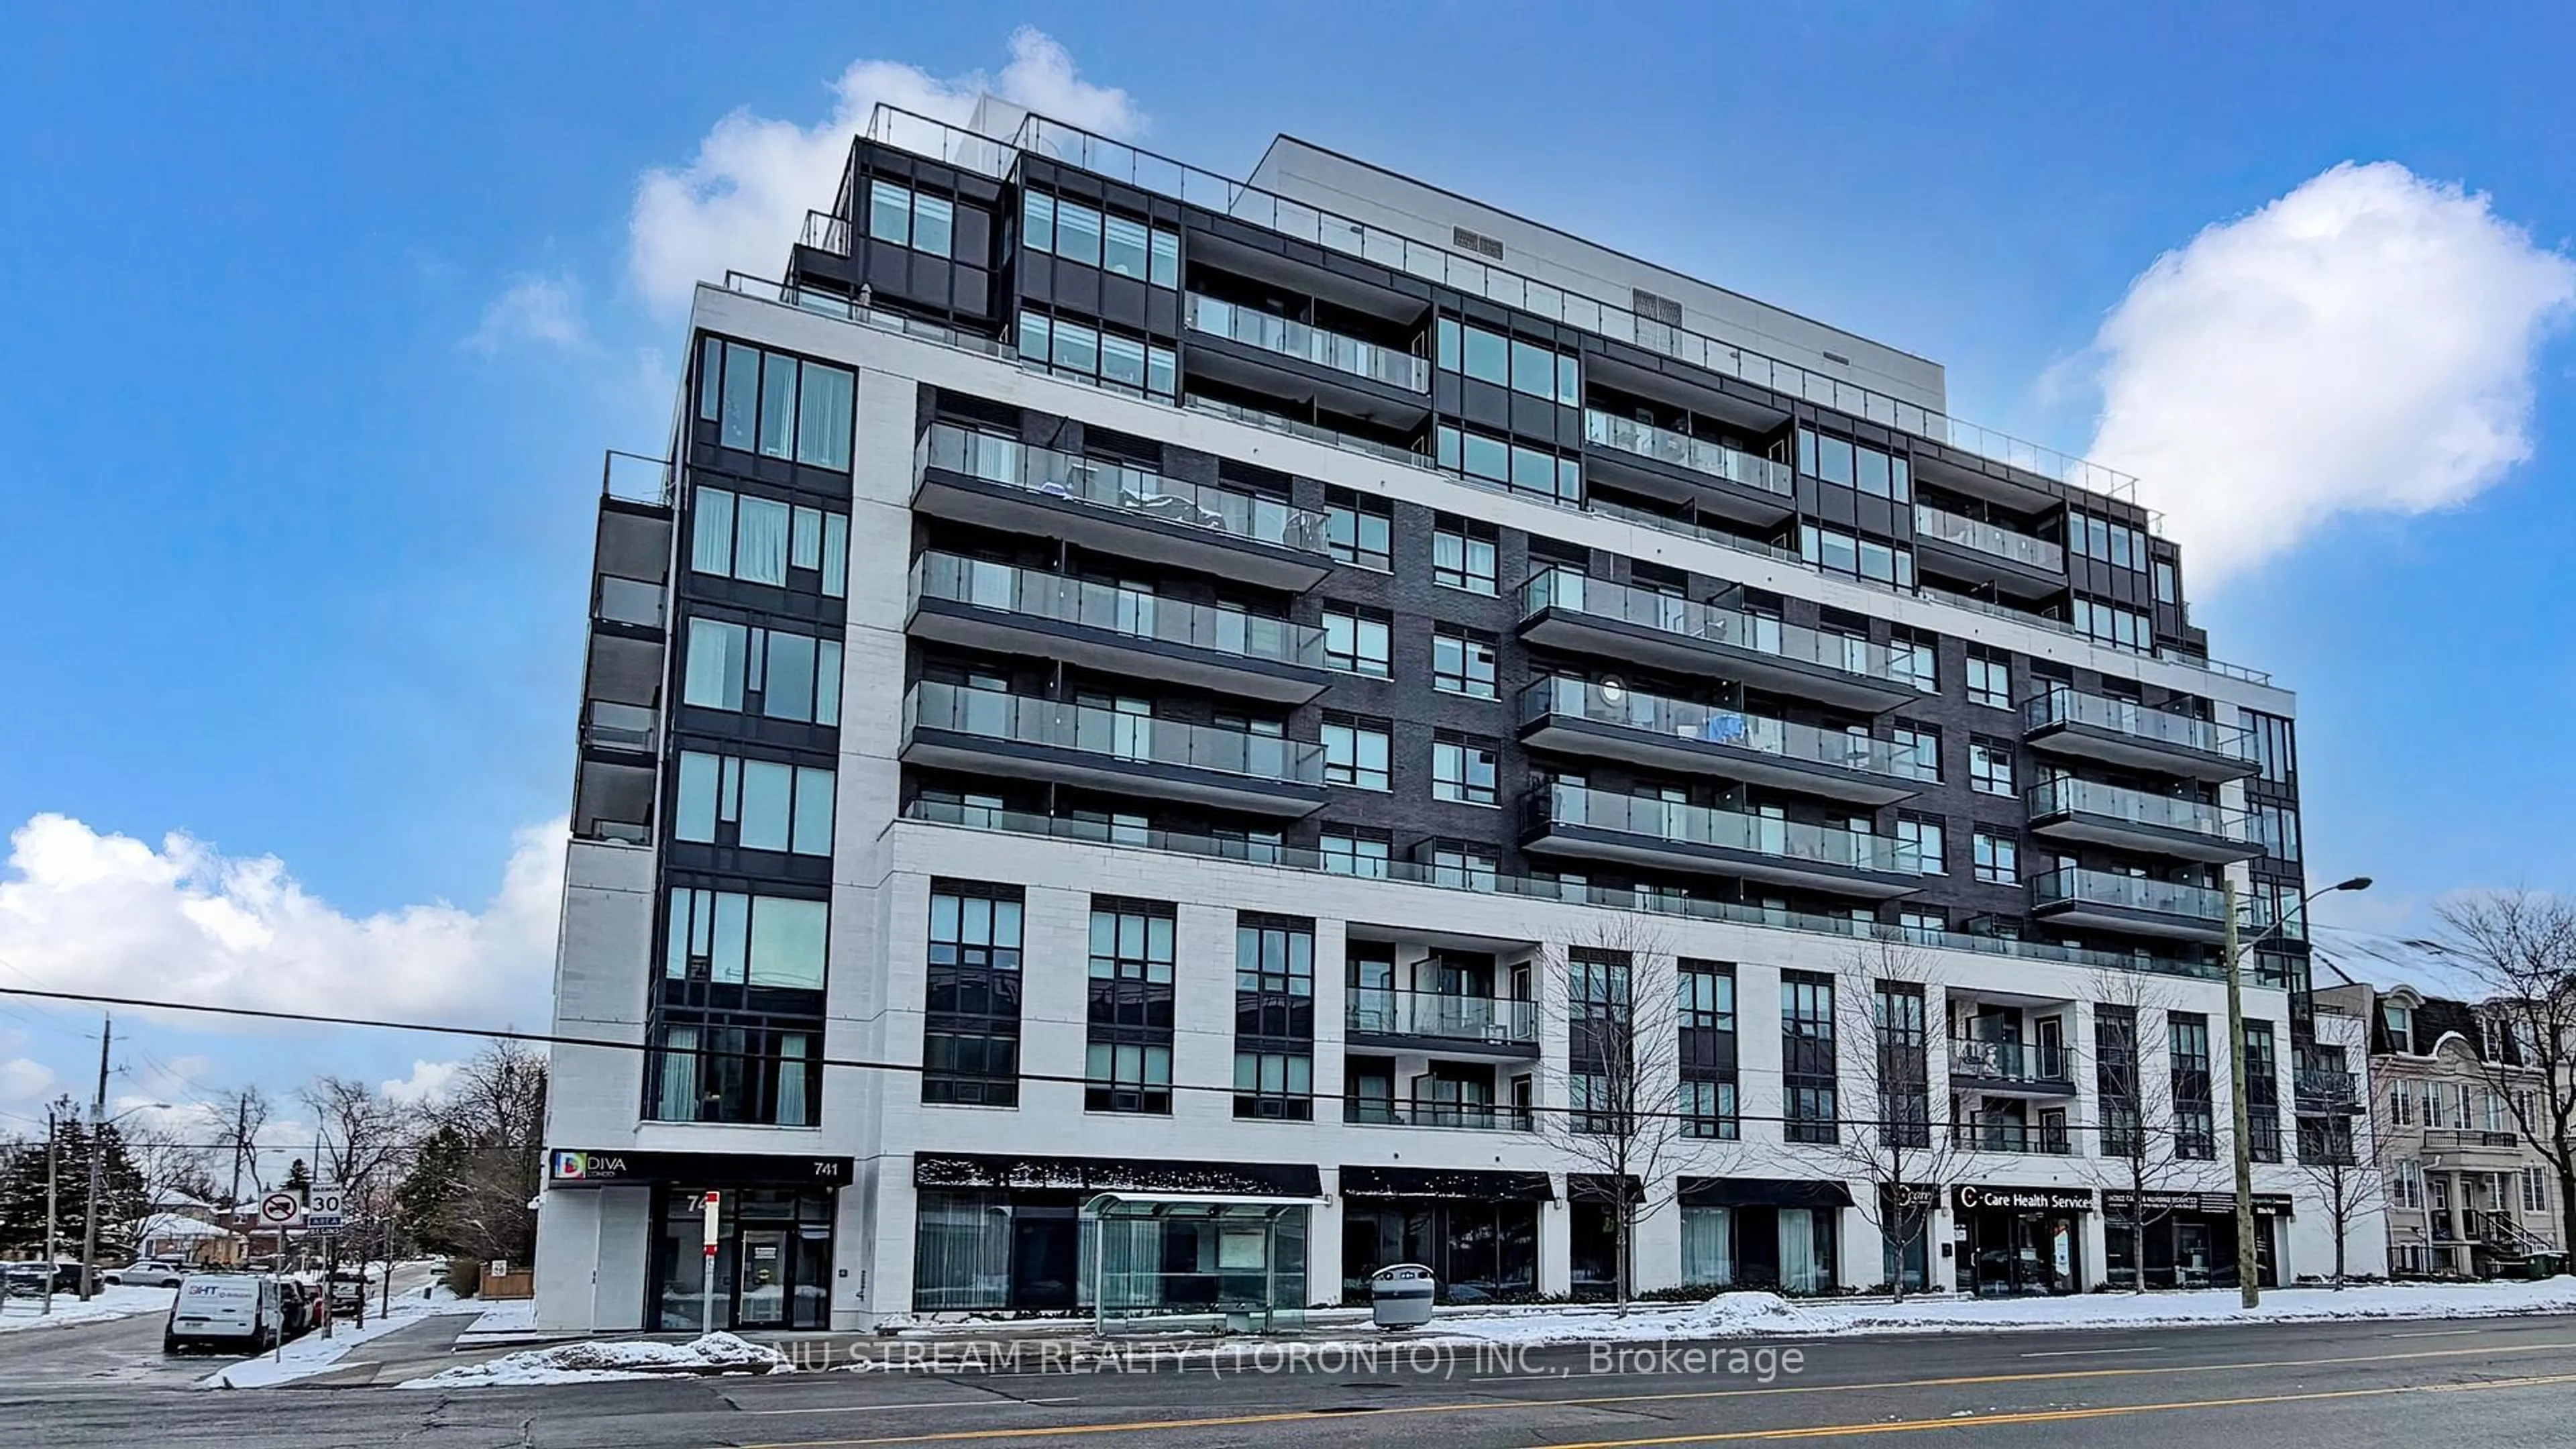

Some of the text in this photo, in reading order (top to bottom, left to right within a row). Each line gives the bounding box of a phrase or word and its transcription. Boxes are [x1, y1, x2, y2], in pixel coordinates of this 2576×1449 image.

[587, 1157, 627, 1171] DIVA
[814, 1162, 838, 1175] 741
[313, 1196, 339, 1212] 30
[2013, 1193, 2048, 1208] Health
[2051, 1195, 2094, 1208] Services
